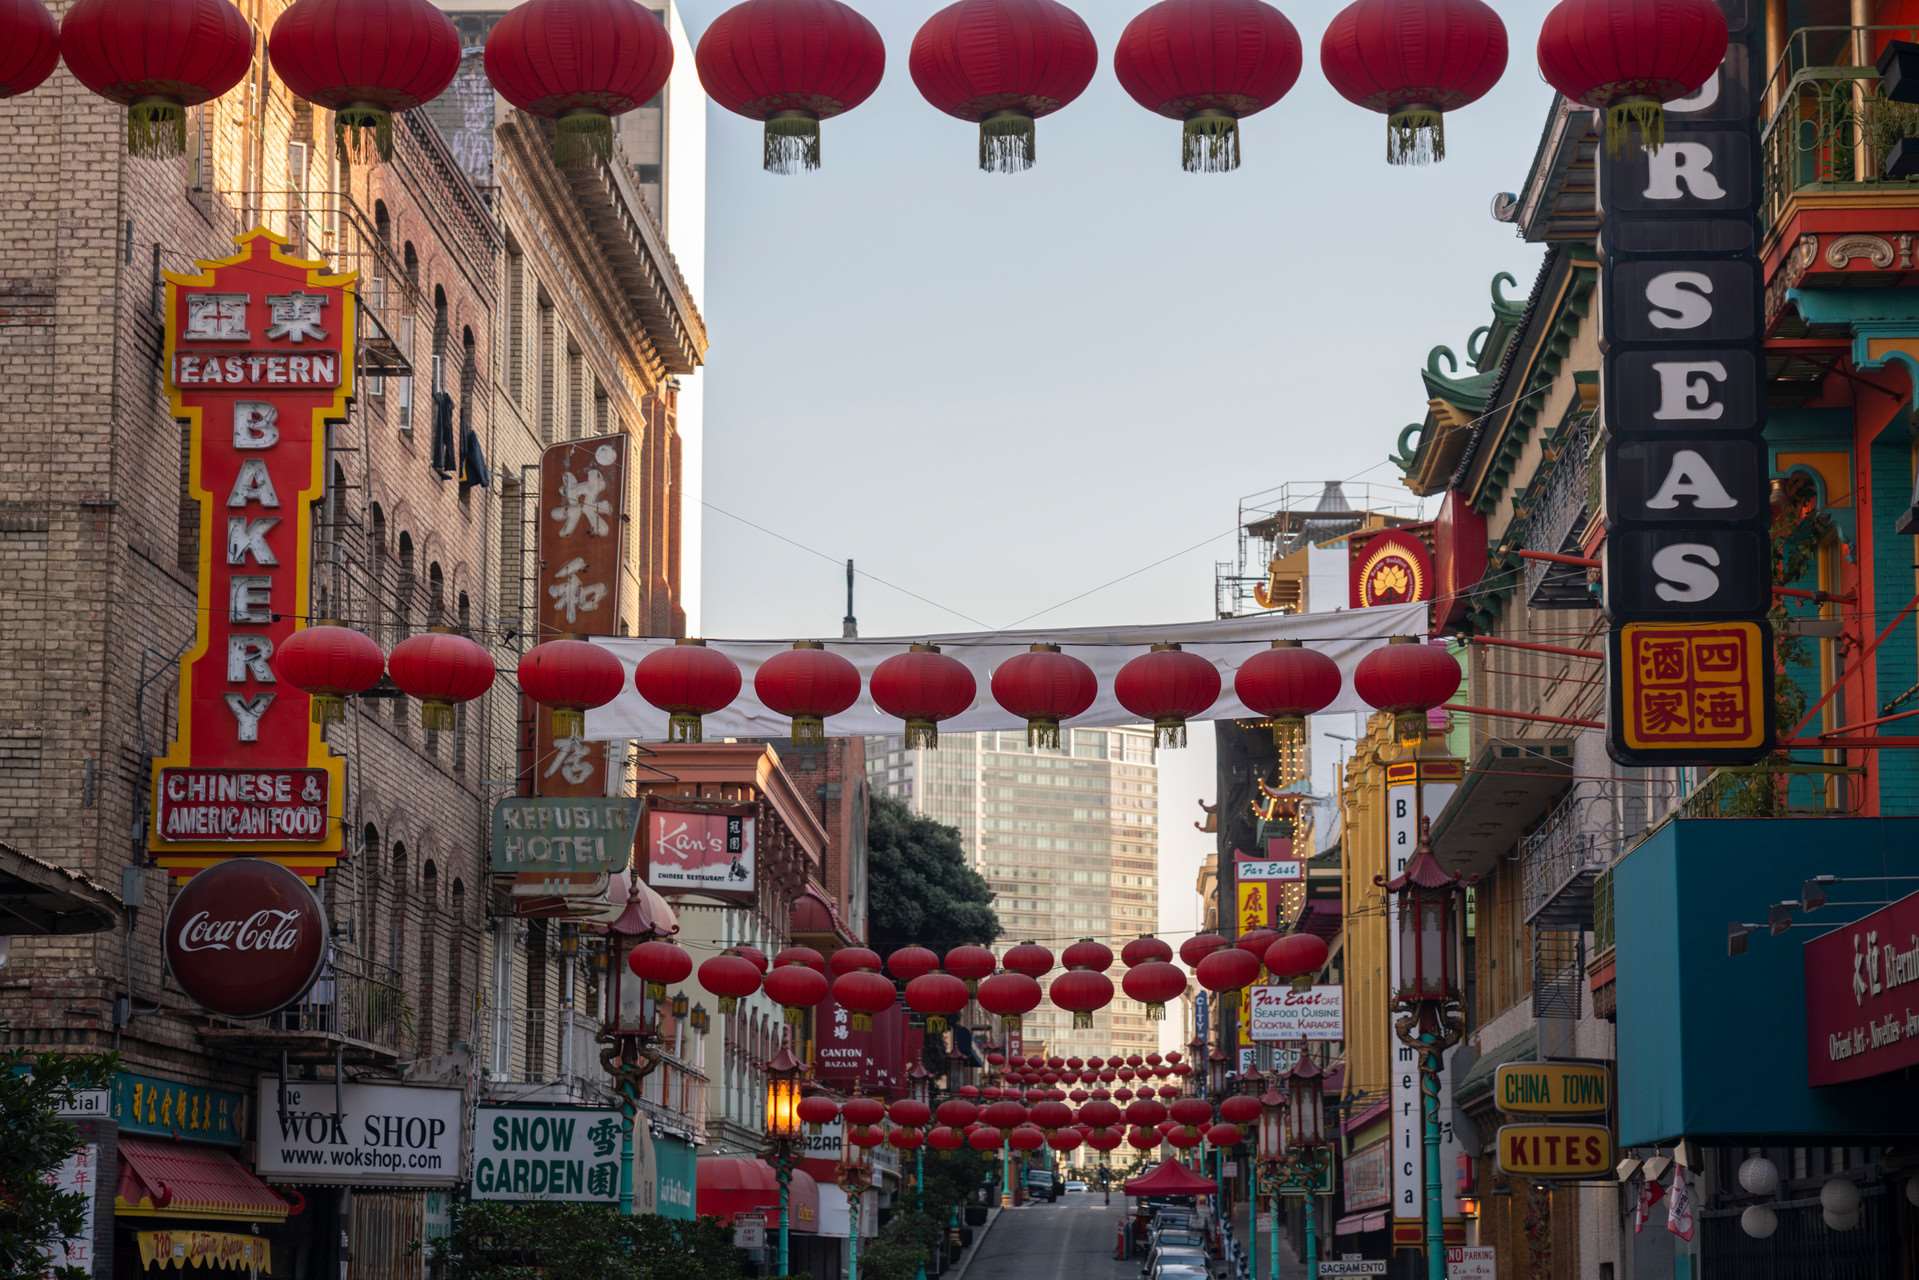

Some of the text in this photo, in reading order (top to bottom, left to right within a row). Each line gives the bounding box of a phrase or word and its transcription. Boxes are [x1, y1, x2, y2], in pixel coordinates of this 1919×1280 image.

[180, 356, 335, 384] EASTERN
[1645, 271, 1738, 603] SEAS
[225, 401, 281, 742] BAKERY
[167, 774, 322, 802] CHINESE &
[167, 807, 322, 834] AMERICAN FOOD
[504, 835, 612, 864] HOTEL
[656, 816, 724, 860] Kan's
[1242, 863, 1296, 876] Far East
[178, 910, 302, 951] Coca-Cola
[1254, 989, 1281, 1007] Far
[1284, 990, 1322, 1006] East
[1253, 1018, 1341, 1030] COCKTAIL KARAOKE
[1254, 1007, 1340, 1018] SEAFOOD CUISINE
[820, 1048, 862, 1058] CANTON
[824, 1060, 859, 1069] BAZAAR
[1505, 1073, 1605, 1105] CHINA TOWN
[276, 1110, 446, 1149] WOK SHOP
[493, 1116, 576, 1152] SNOW
[281, 1148, 442, 1172] www.wokshop.com
[1510, 1135, 1603, 1166] KITES
[476, 1158, 585, 1194] GARDEN
[1321, 1262, 1385, 1274] SACRAMENTO
[1448, 1249, 1494, 1262] NO PARKING
